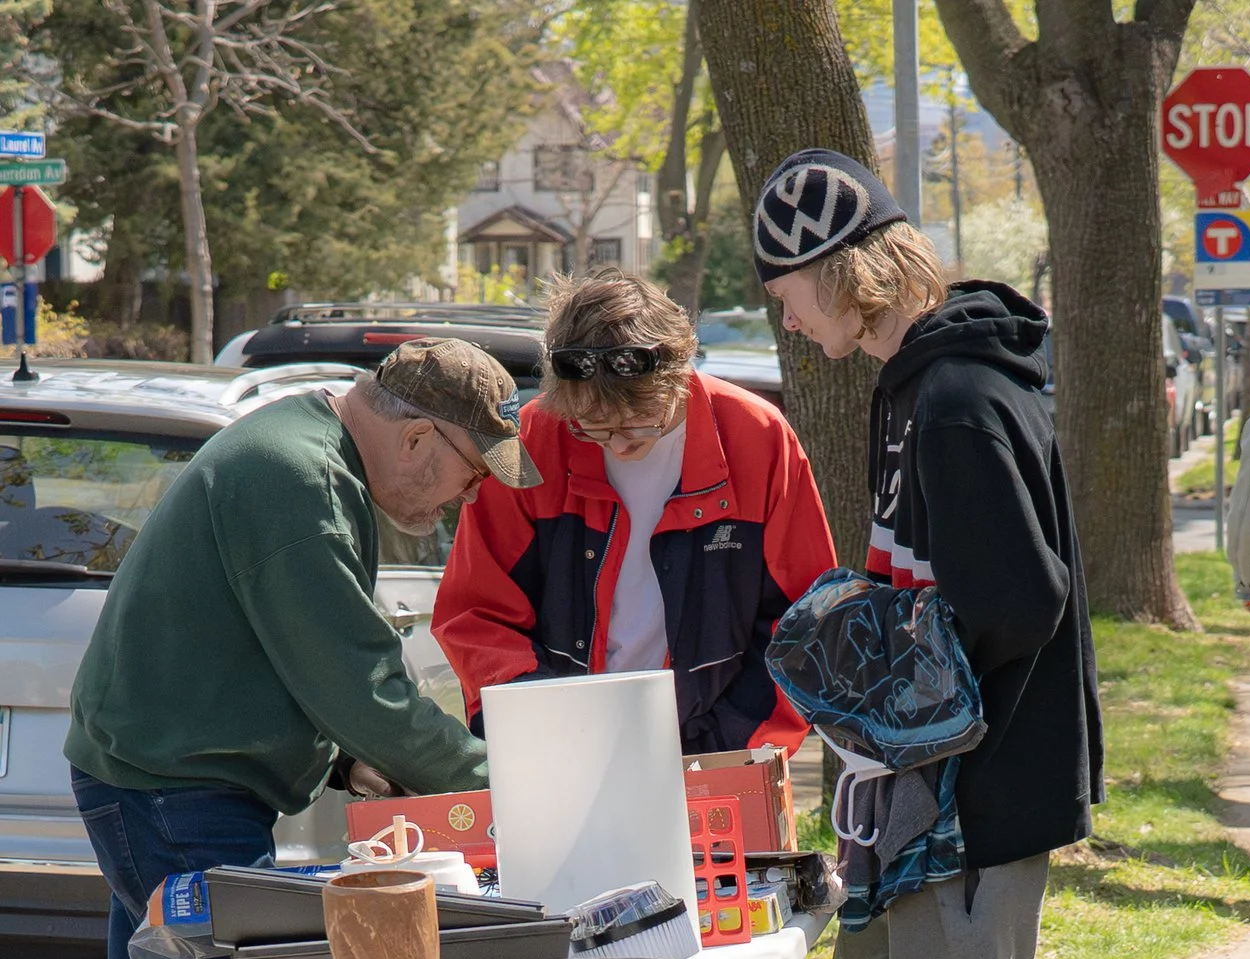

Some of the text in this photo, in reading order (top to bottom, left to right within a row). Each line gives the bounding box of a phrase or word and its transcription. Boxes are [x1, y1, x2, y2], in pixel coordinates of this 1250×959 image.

[1, 136, 30, 152] Laurel
[1206, 227, 1238, 255] T
[176, 893, 191, 917] PIPE
